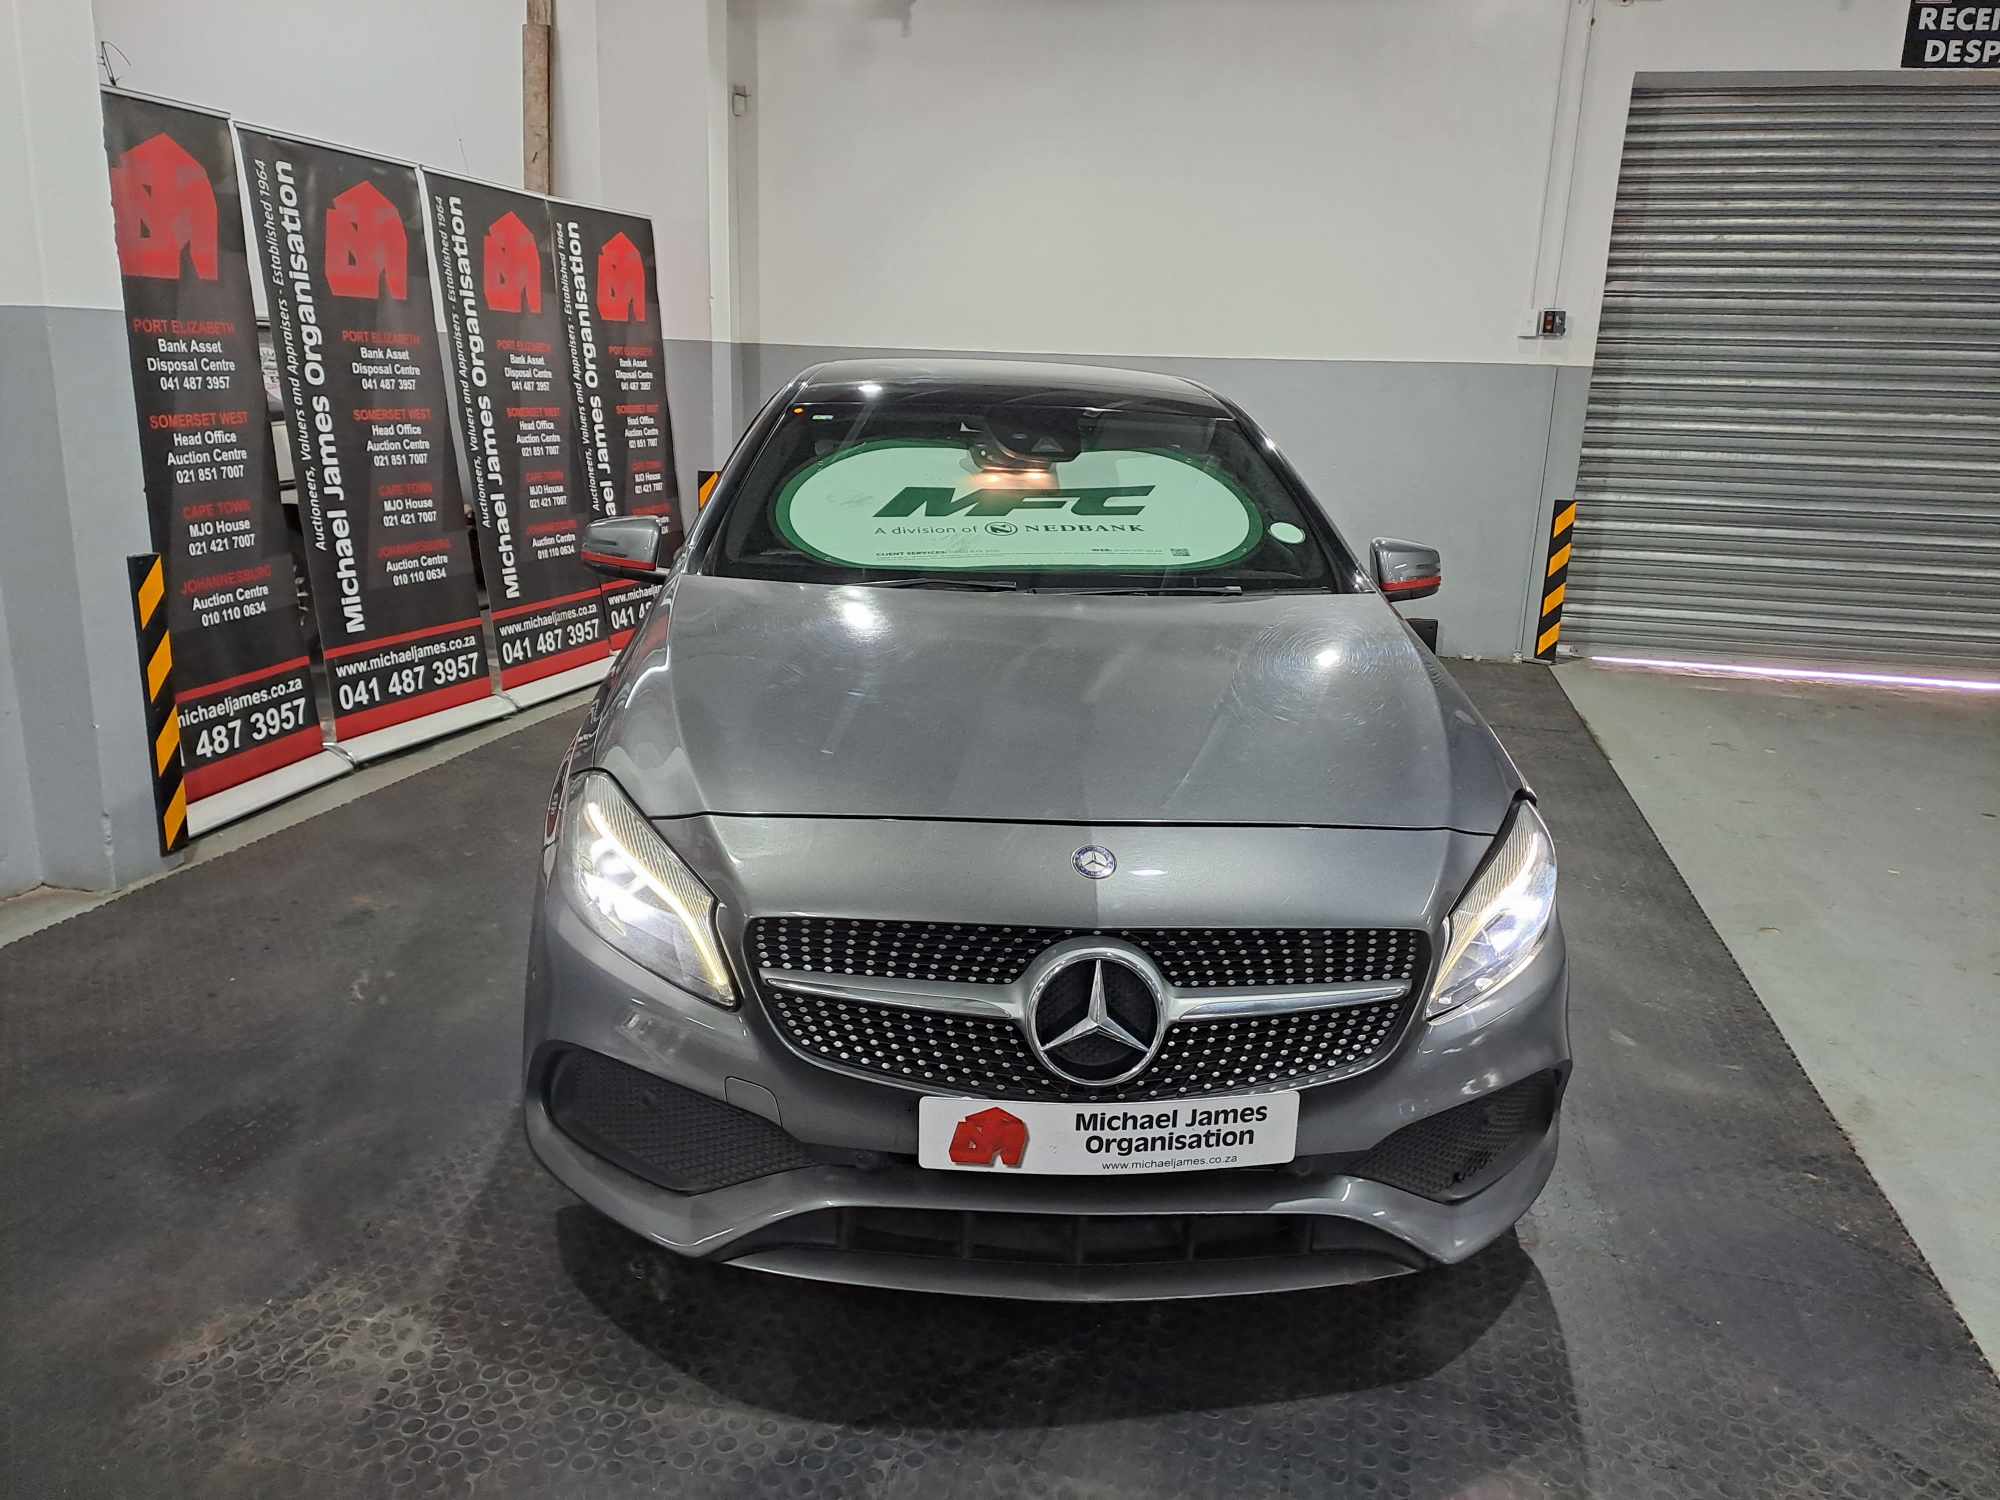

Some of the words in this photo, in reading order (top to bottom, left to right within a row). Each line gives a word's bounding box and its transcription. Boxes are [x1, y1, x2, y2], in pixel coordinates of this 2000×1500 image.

[1924, 40, 2000, 63] DESP
[255, 160, 271, 199] 1964
[435, 196, 448, 228] 1964
[260, 200, 284, 286] Established
[275, 160, 326, 386] Organisation
[439, 230, 457, 302] Established
[449, 196, 487, 387] Organisation
[568, 222, 599, 388] Organisation
[133, 319, 167, 333] PORT
[279, 299, 300, 378] Appraisers
[158, 338, 188, 352] Bank
[190, 339, 222, 352] Asset
[360, 347, 384, 359] Bank
[386, 348, 410, 360] Asset
[452, 314, 469, 378] Appraisers
[147, 358, 198, 374] Disposal
[200, 358, 236, 371] Centre
[352, 362, 392, 376] Disposal
[394, 364, 420, 376] Centre
[160, 377, 179, 390] 041
[183, 376, 202, 390] 487
[206, 376, 230, 389] 3957
[288, 378, 305, 406] and
[362, 378, 377, 390] 041
[380, 379, 395, 390] 487
[398, 380, 416, 390] 3957
[459, 378, 472, 402] and
[574, 382, 584, 404] and
[150, 412, 216, 428] SOMERSET
[219, 411, 248, 424] WEST
[372, 424, 394, 436] Head
[396, 424, 422, 435] Office
[465, 406, 478, 451] Valuers
[578, 406, 590, 444] Valuers
[173, 432, 201, 446] Head
[204, 430, 236, 444] Office
[298, 410, 312, 461] Valuers
[312, 395, 344, 501] James
[367, 440, 401, 452] Auction
[403, 439, 430, 450] Centre
[478, 395, 502, 486] James
[590, 396, 610, 474] James
[168, 451, 210, 466] Auction
[213, 448, 248, 462] Centre
[374, 456, 388, 467] 021
[391, 454, 406, 466] 851
[408, 454, 428, 464] 7007
[176, 470, 194, 484] 021
[198, 468, 217, 482] 851
[220, 465, 244, 479] 7007
[384, 500, 404, 512] MJO
[405, 498, 433, 510] House
[473, 456, 491, 528] Auctioneers,
[872, 485, 1156, 518] MFC
[305, 467, 327, 550] Auctioneers,
[383, 516, 398, 526] 021
[400, 514, 415, 525] 421
[418, 511, 437, 523] 7007
[189, 522, 213, 538] MJO
[216, 519, 250, 534] House
[874, 527, 888, 536] A
[892, 526, 956, 536] division
[962, 526, 978, 534] of
[1025, 524, 1144, 532] NEDBANK
[188, 542, 207, 556] 021
[210, 538, 228, 552] 421
[232, 534, 256, 548] 7007
[490, 492, 520, 599] Michael
[327, 509, 366, 634] Michael
[386, 560, 418, 572] Auction
[420, 555, 448, 566] Centre
[392, 575, 408, 586] 010
[410, 572, 424, 584] 110
[426, 568, 446, 581] 0634
[192, 595, 234, 611] Auction
[236, 584, 269, 601] Centre
[202, 612, 220, 627] 010
[222, 606, 241, 622] 110
[244, 600, 267, 616] 0634
[500, 603, 597, 636] www.michaeljames.co.za
[611, 607, 634, 630] 041
[502, 632, 532, 664] 041
[536, 629, 562, 654] 487
[568, 618, 599, 645] 3957
[336, 635, 476, 678] www.michaeljames.co.za
[338, 676, 380, 711] 041
[388, 666, 425, 696] 487
[432, 652, 478, 684] 3957
[196, 719, 242, 758] 487
[250, 698, 306, 740] 3957
[1075, 1110, 1178, 1132] Michael
[1186, 1105, 1268, 1127] James
[1086, 1127, 1254, 1156] Organisation
[1102, 1154, 1238, 1170] www.michaeljames.co.za
